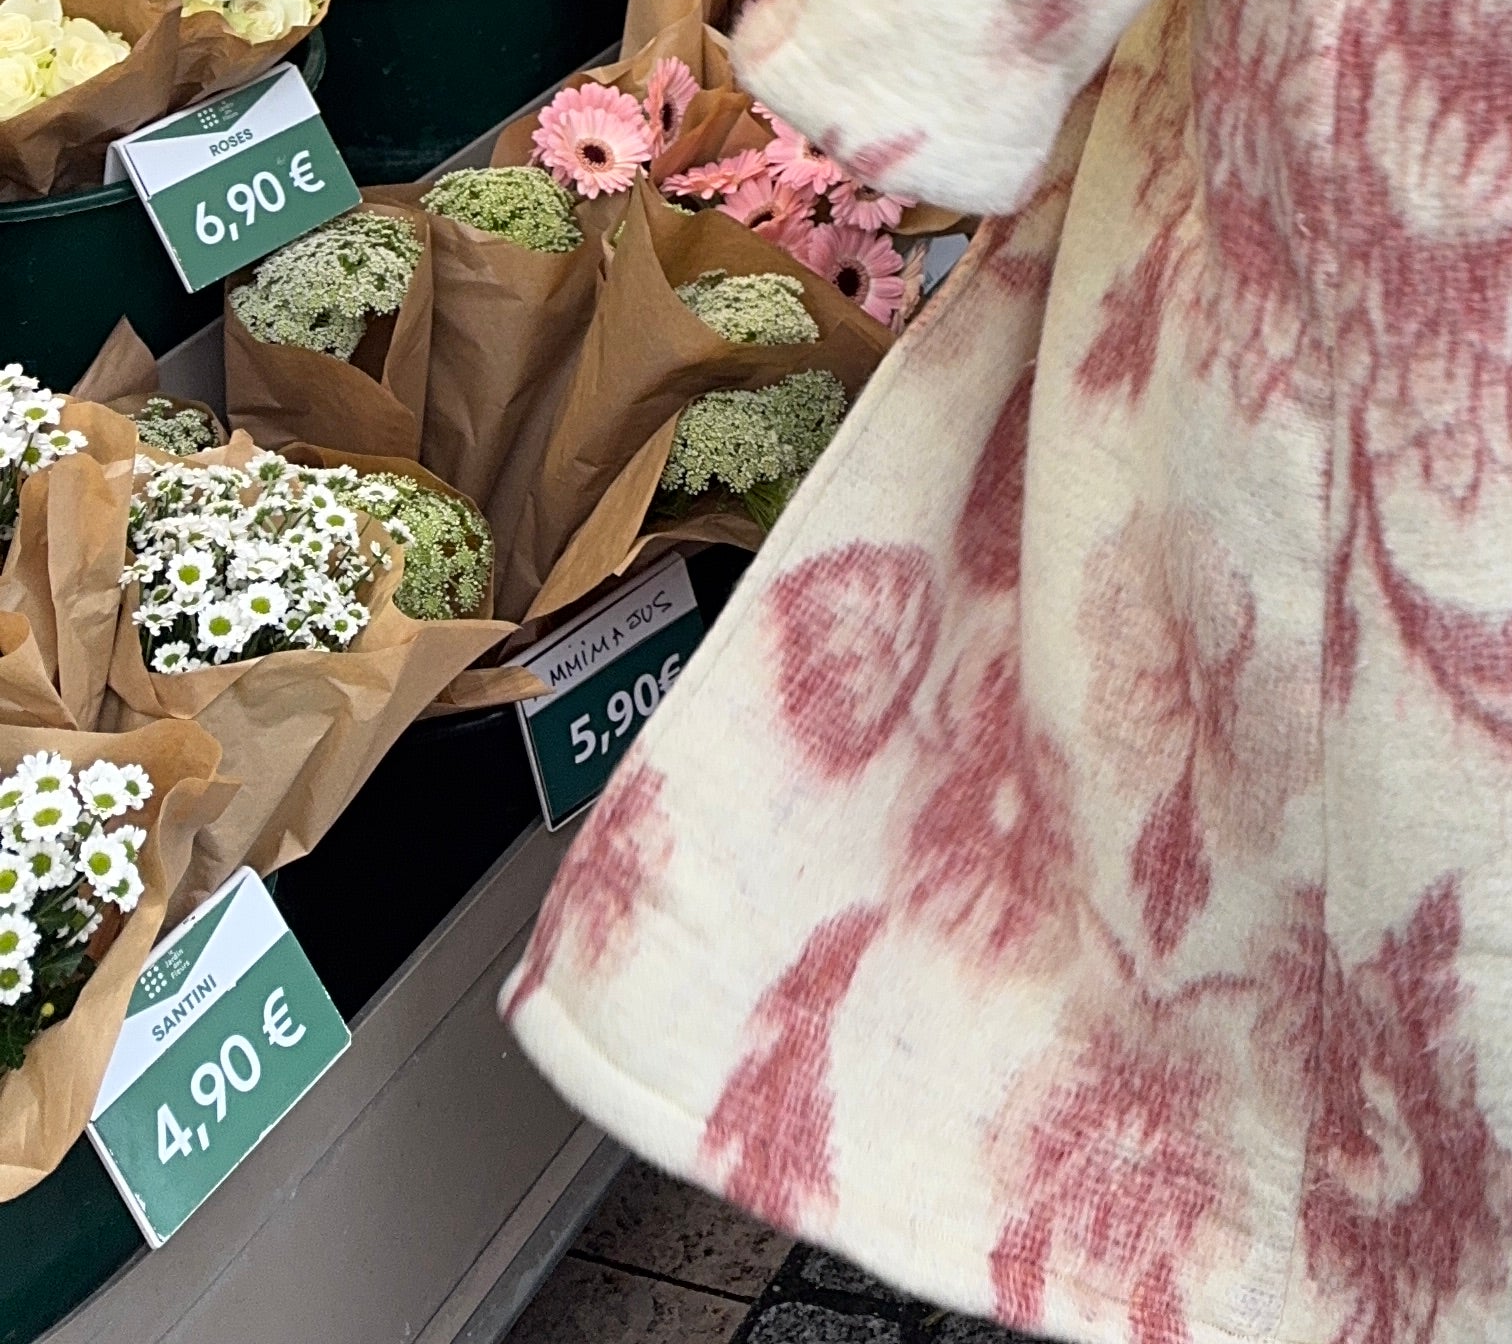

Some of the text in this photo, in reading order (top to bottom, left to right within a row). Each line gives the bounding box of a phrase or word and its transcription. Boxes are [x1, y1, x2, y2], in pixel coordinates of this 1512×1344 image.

[209, 128, 254, 157] ROSES
[195, 150, 326, 245] 6,90 €
[569, 652, 681, 764] 5,90€
[152, 973, 217, 1042] SANTINI
[156, 986, 307, 1165] 4,90 €
